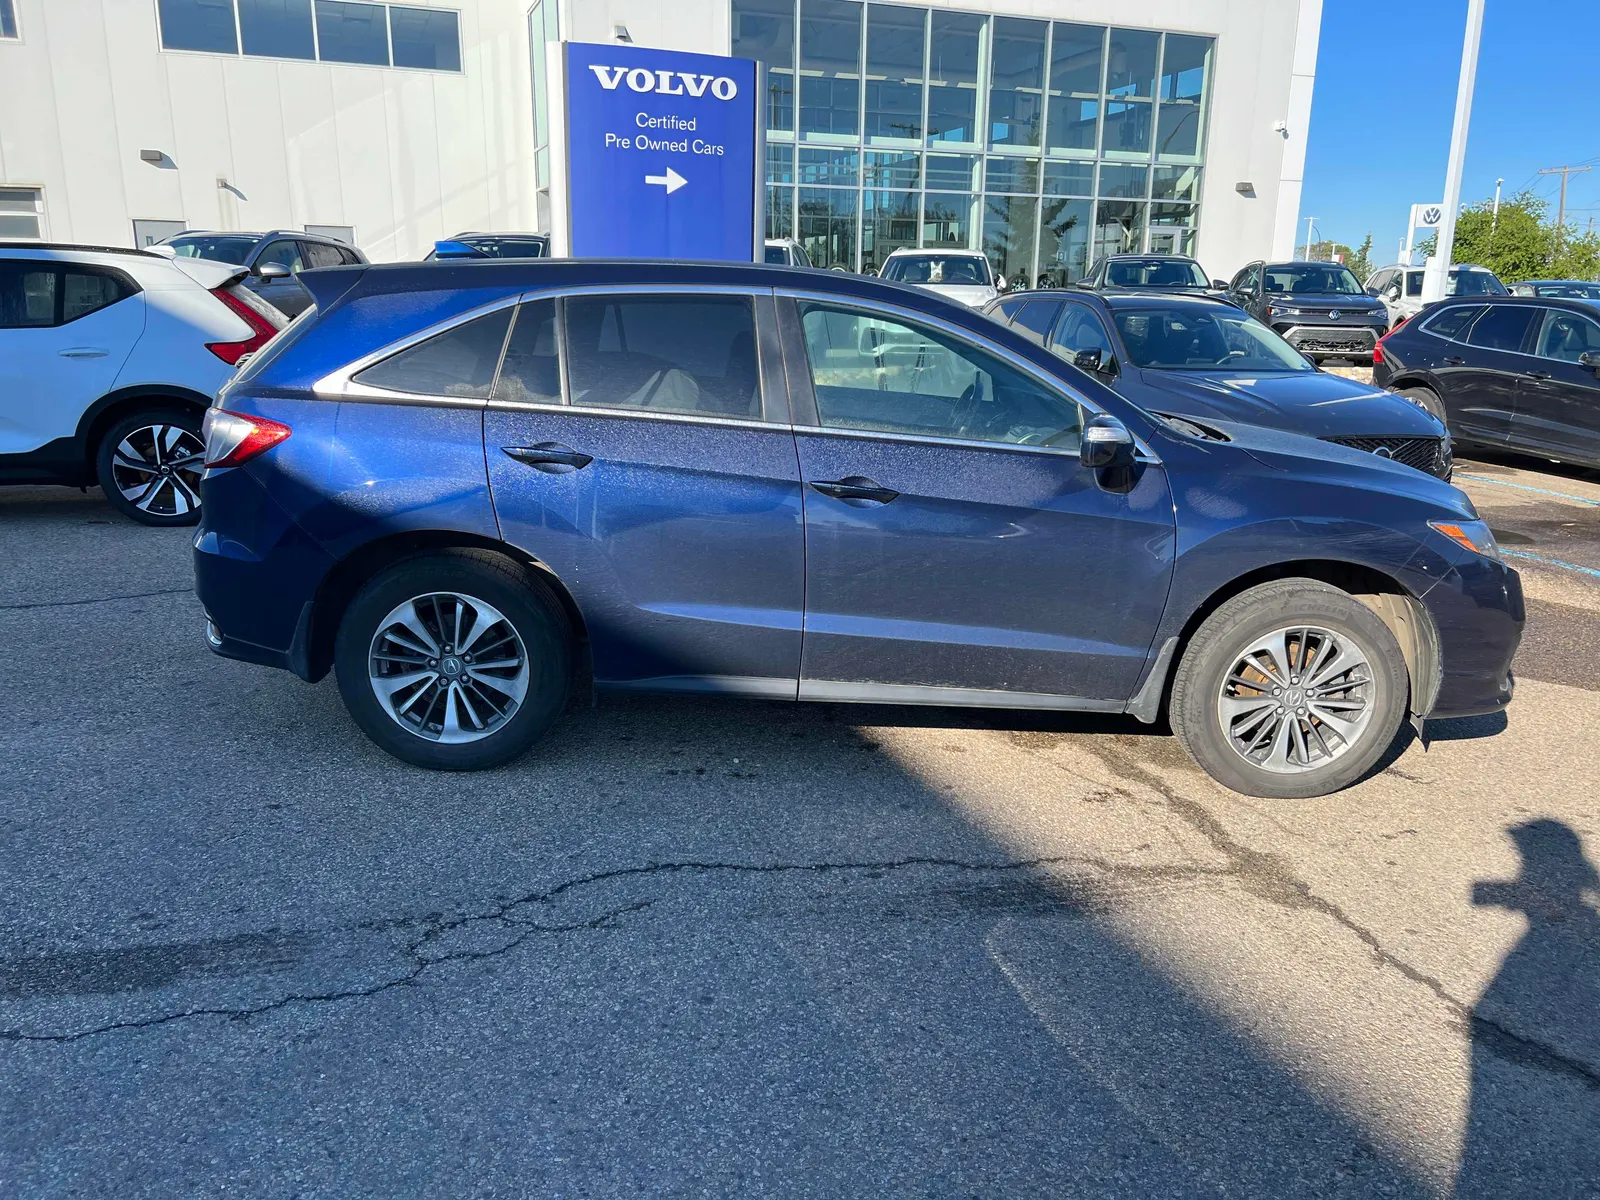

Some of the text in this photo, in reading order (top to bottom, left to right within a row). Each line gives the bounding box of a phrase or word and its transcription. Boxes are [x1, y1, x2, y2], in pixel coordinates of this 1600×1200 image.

[588, 64, 738, 101] VOLVO
[635, 112, 697, 131] Certified
[605, 132, 724, 156] Pre Owned Cars
[1423, 207, 1441, 225] VW
